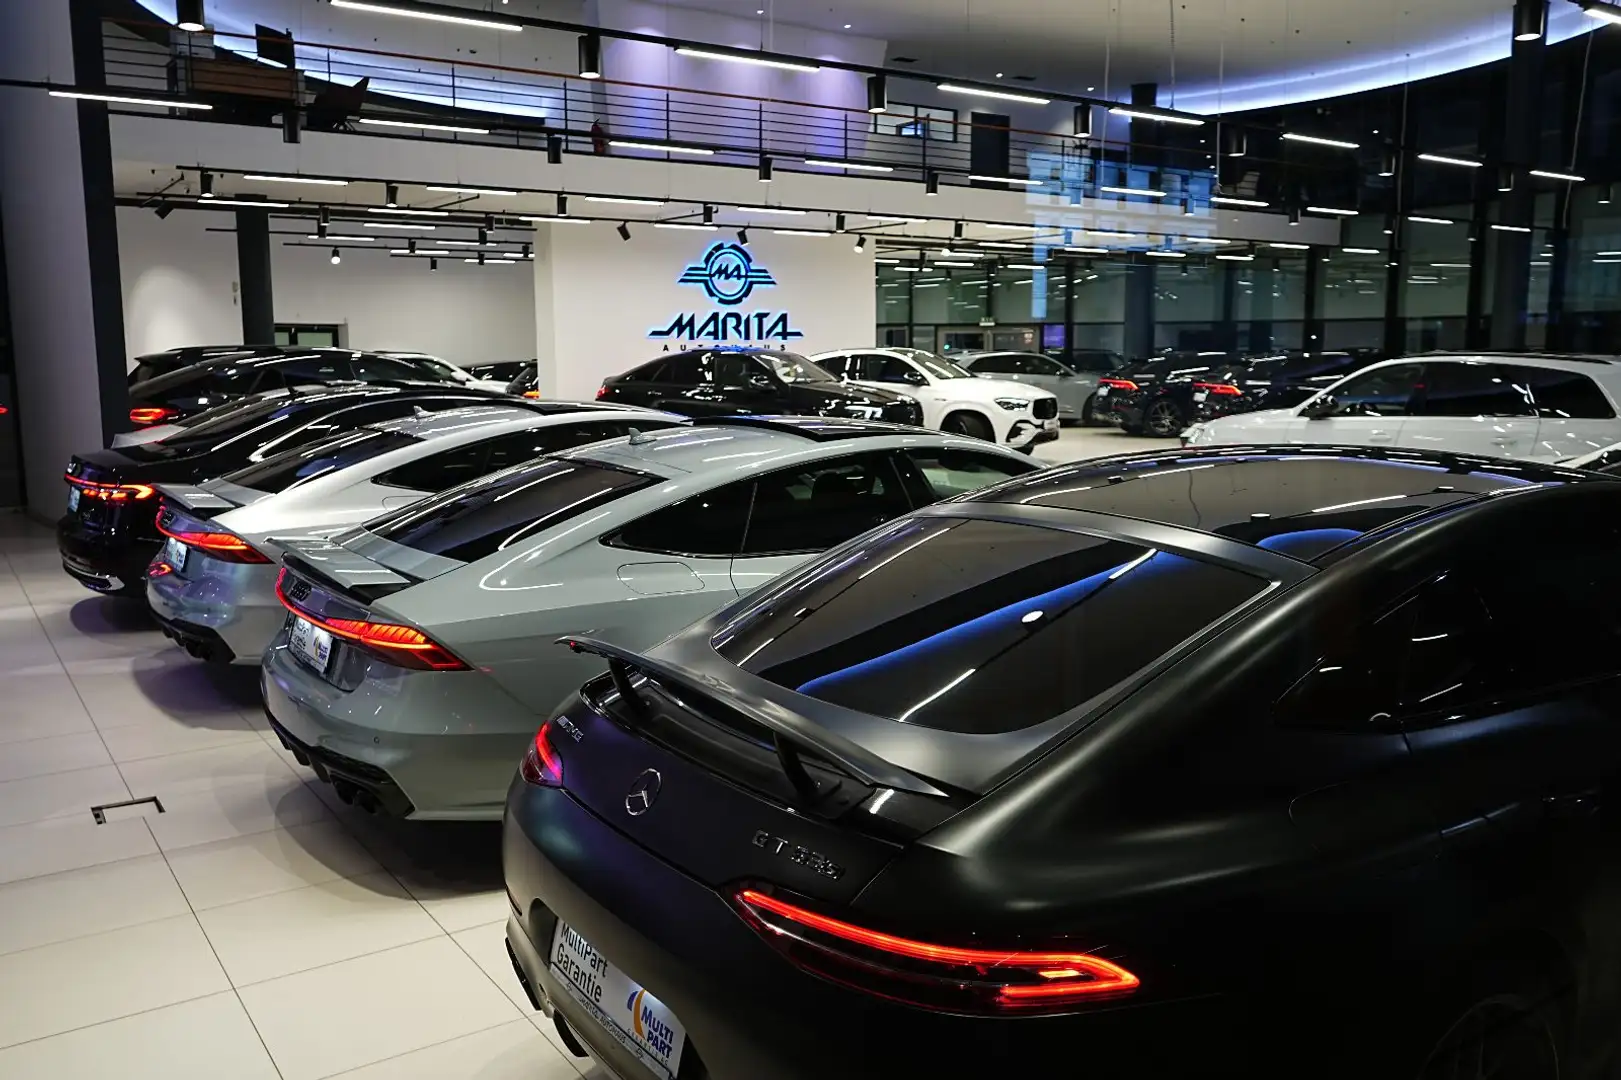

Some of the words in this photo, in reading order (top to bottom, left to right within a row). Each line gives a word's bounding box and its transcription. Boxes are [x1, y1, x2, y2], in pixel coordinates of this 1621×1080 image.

[711, 263, 742, 280] MA
[648, 312, 804, 340] MARITA
[562, 921, 608, 978] MultiPart
[557, 943, 602, 1003] Garantie
[641, 1006, 674, 1044] MULTI
[647, 1030, 673, 1059] PART
